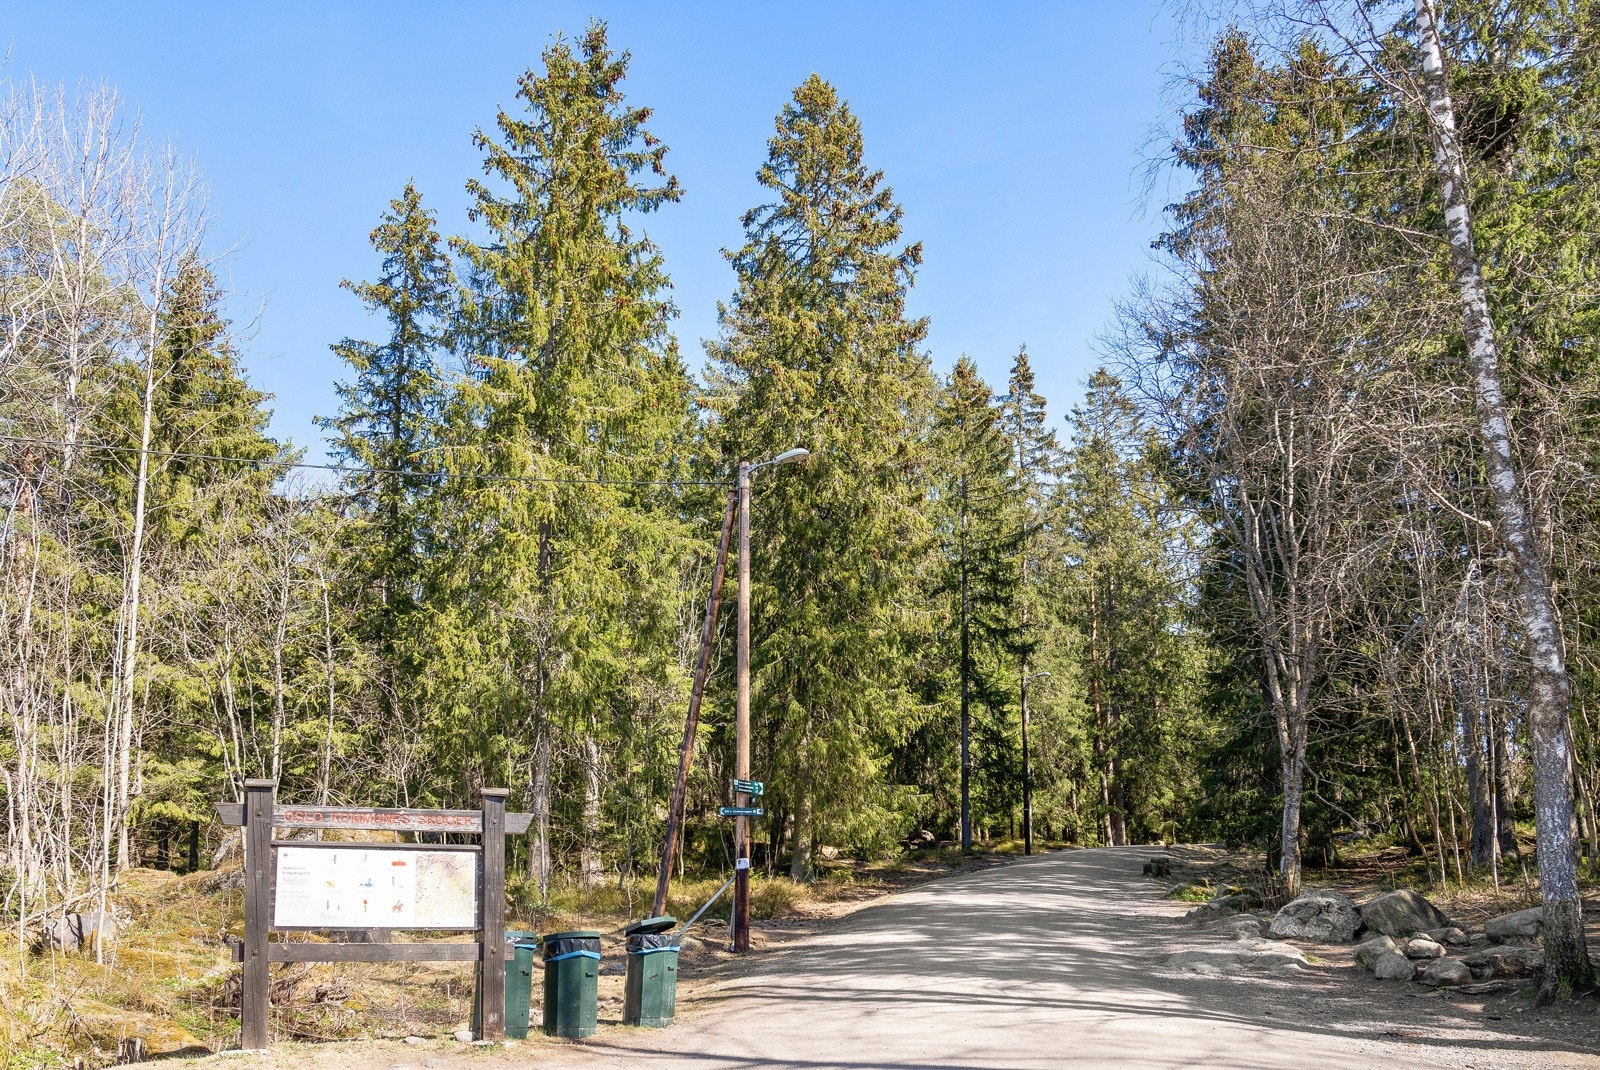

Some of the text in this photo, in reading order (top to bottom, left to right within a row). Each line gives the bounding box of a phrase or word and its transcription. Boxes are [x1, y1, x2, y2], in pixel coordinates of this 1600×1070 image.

[284, 810, 473, 826] OSLO KOMMUNES SKOGER
